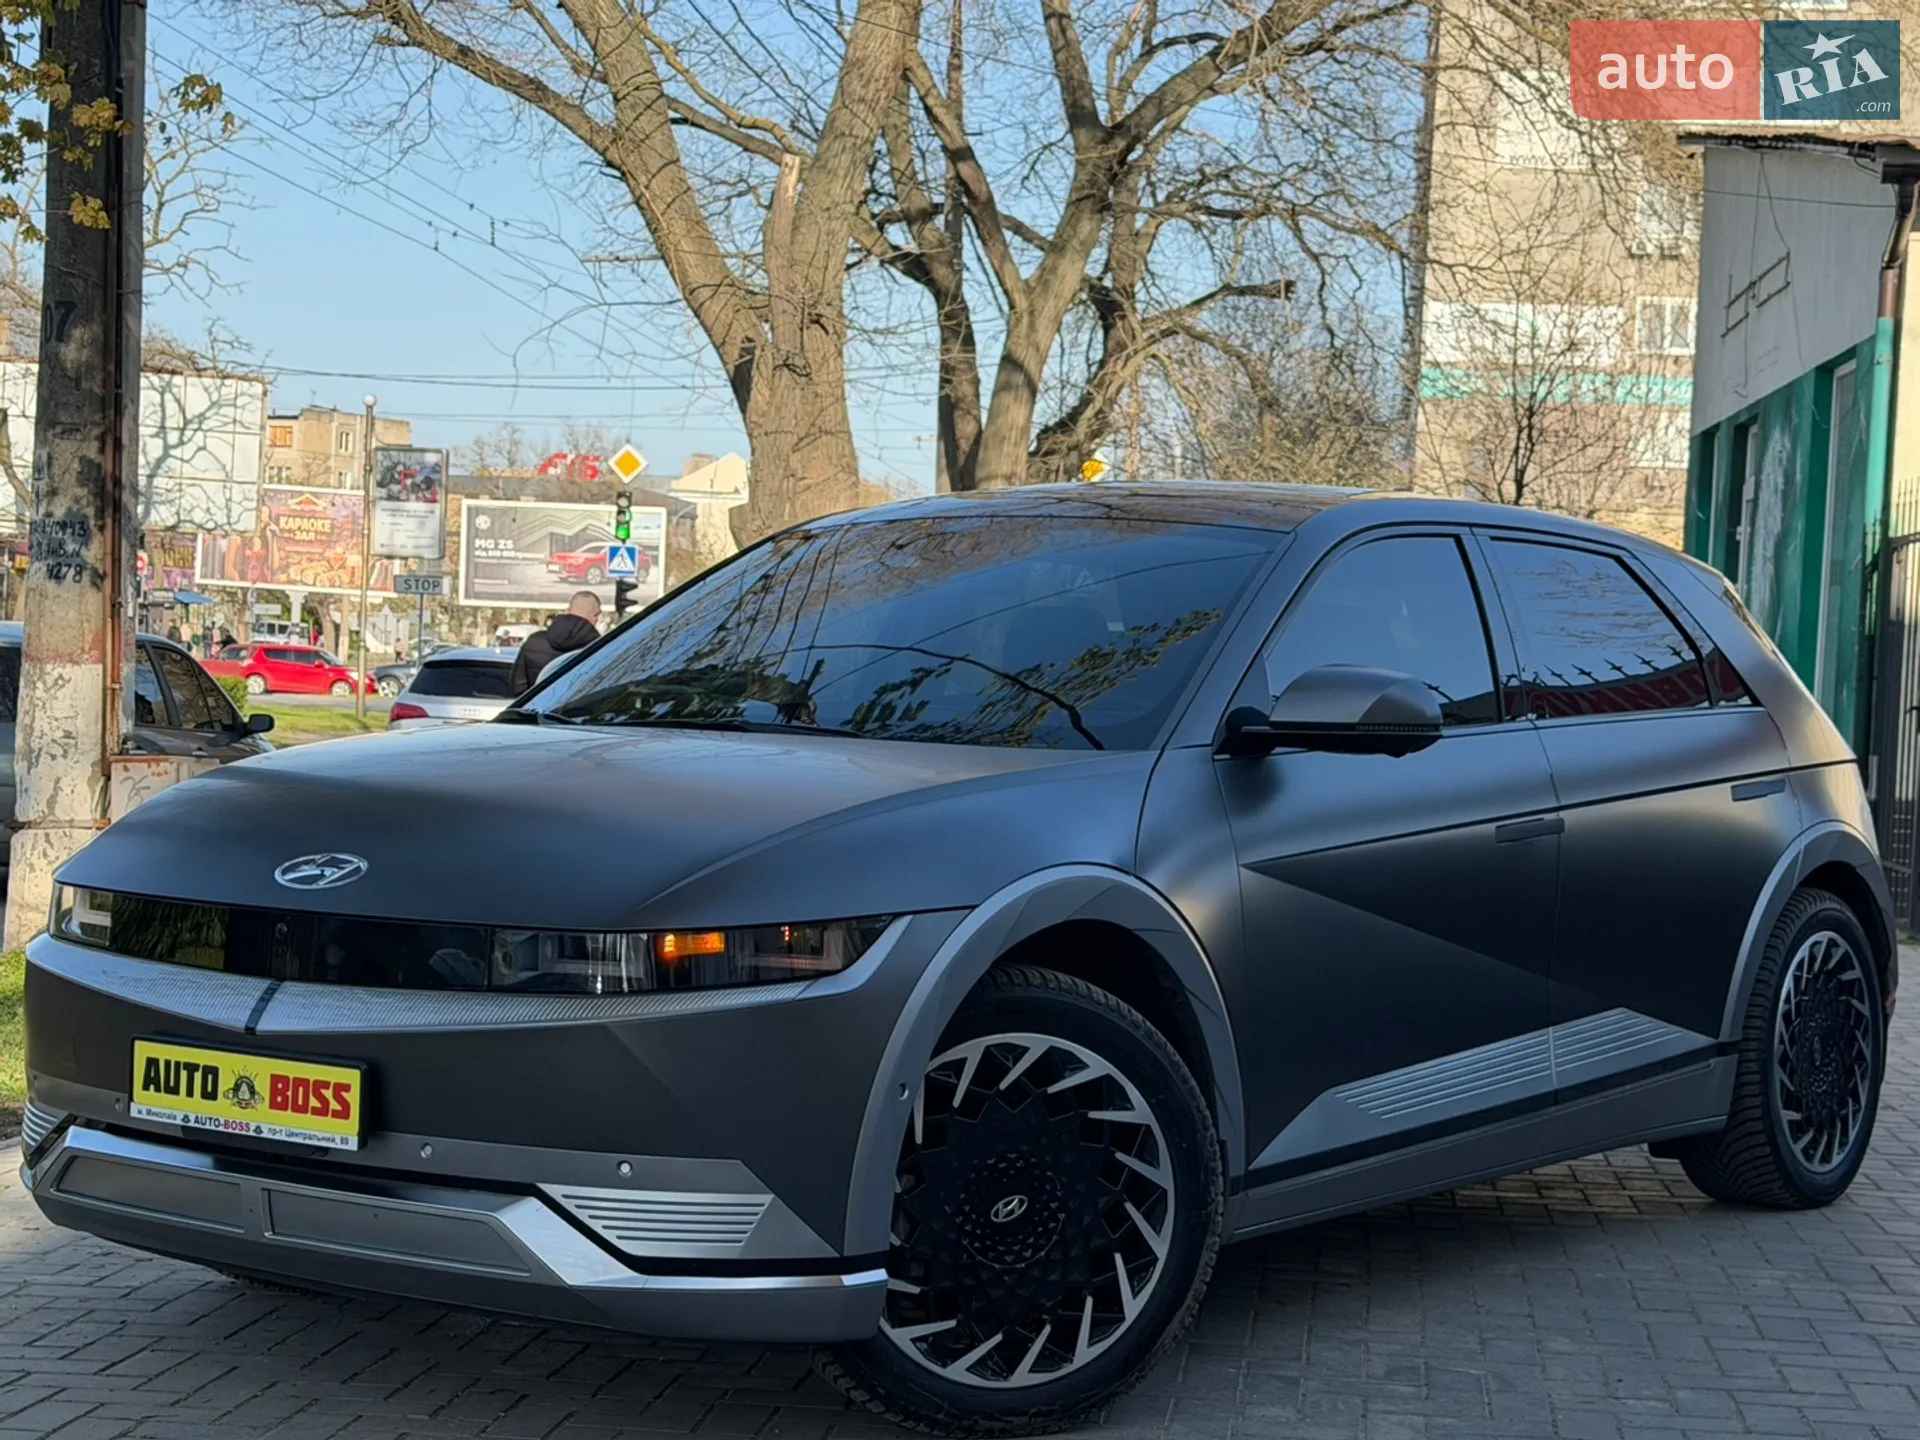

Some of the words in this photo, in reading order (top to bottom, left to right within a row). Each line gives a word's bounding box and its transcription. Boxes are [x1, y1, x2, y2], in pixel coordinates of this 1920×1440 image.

[279, 515, 332, 532] КАРАОКЕ
[295, 530, 316, 541] ЗАЛ
[474, 538, 495, 549] MG
[497, 539, 514, 549] ZS
[403, 578, 440, 592] STOP
[142, 1056, 220, 1102] AUTO
[268, 1073, 351, 1121] BOSS
[193, 1115, 251, 1133] AUTO-BOSS
[340, 1136, 349, 1146] 89
